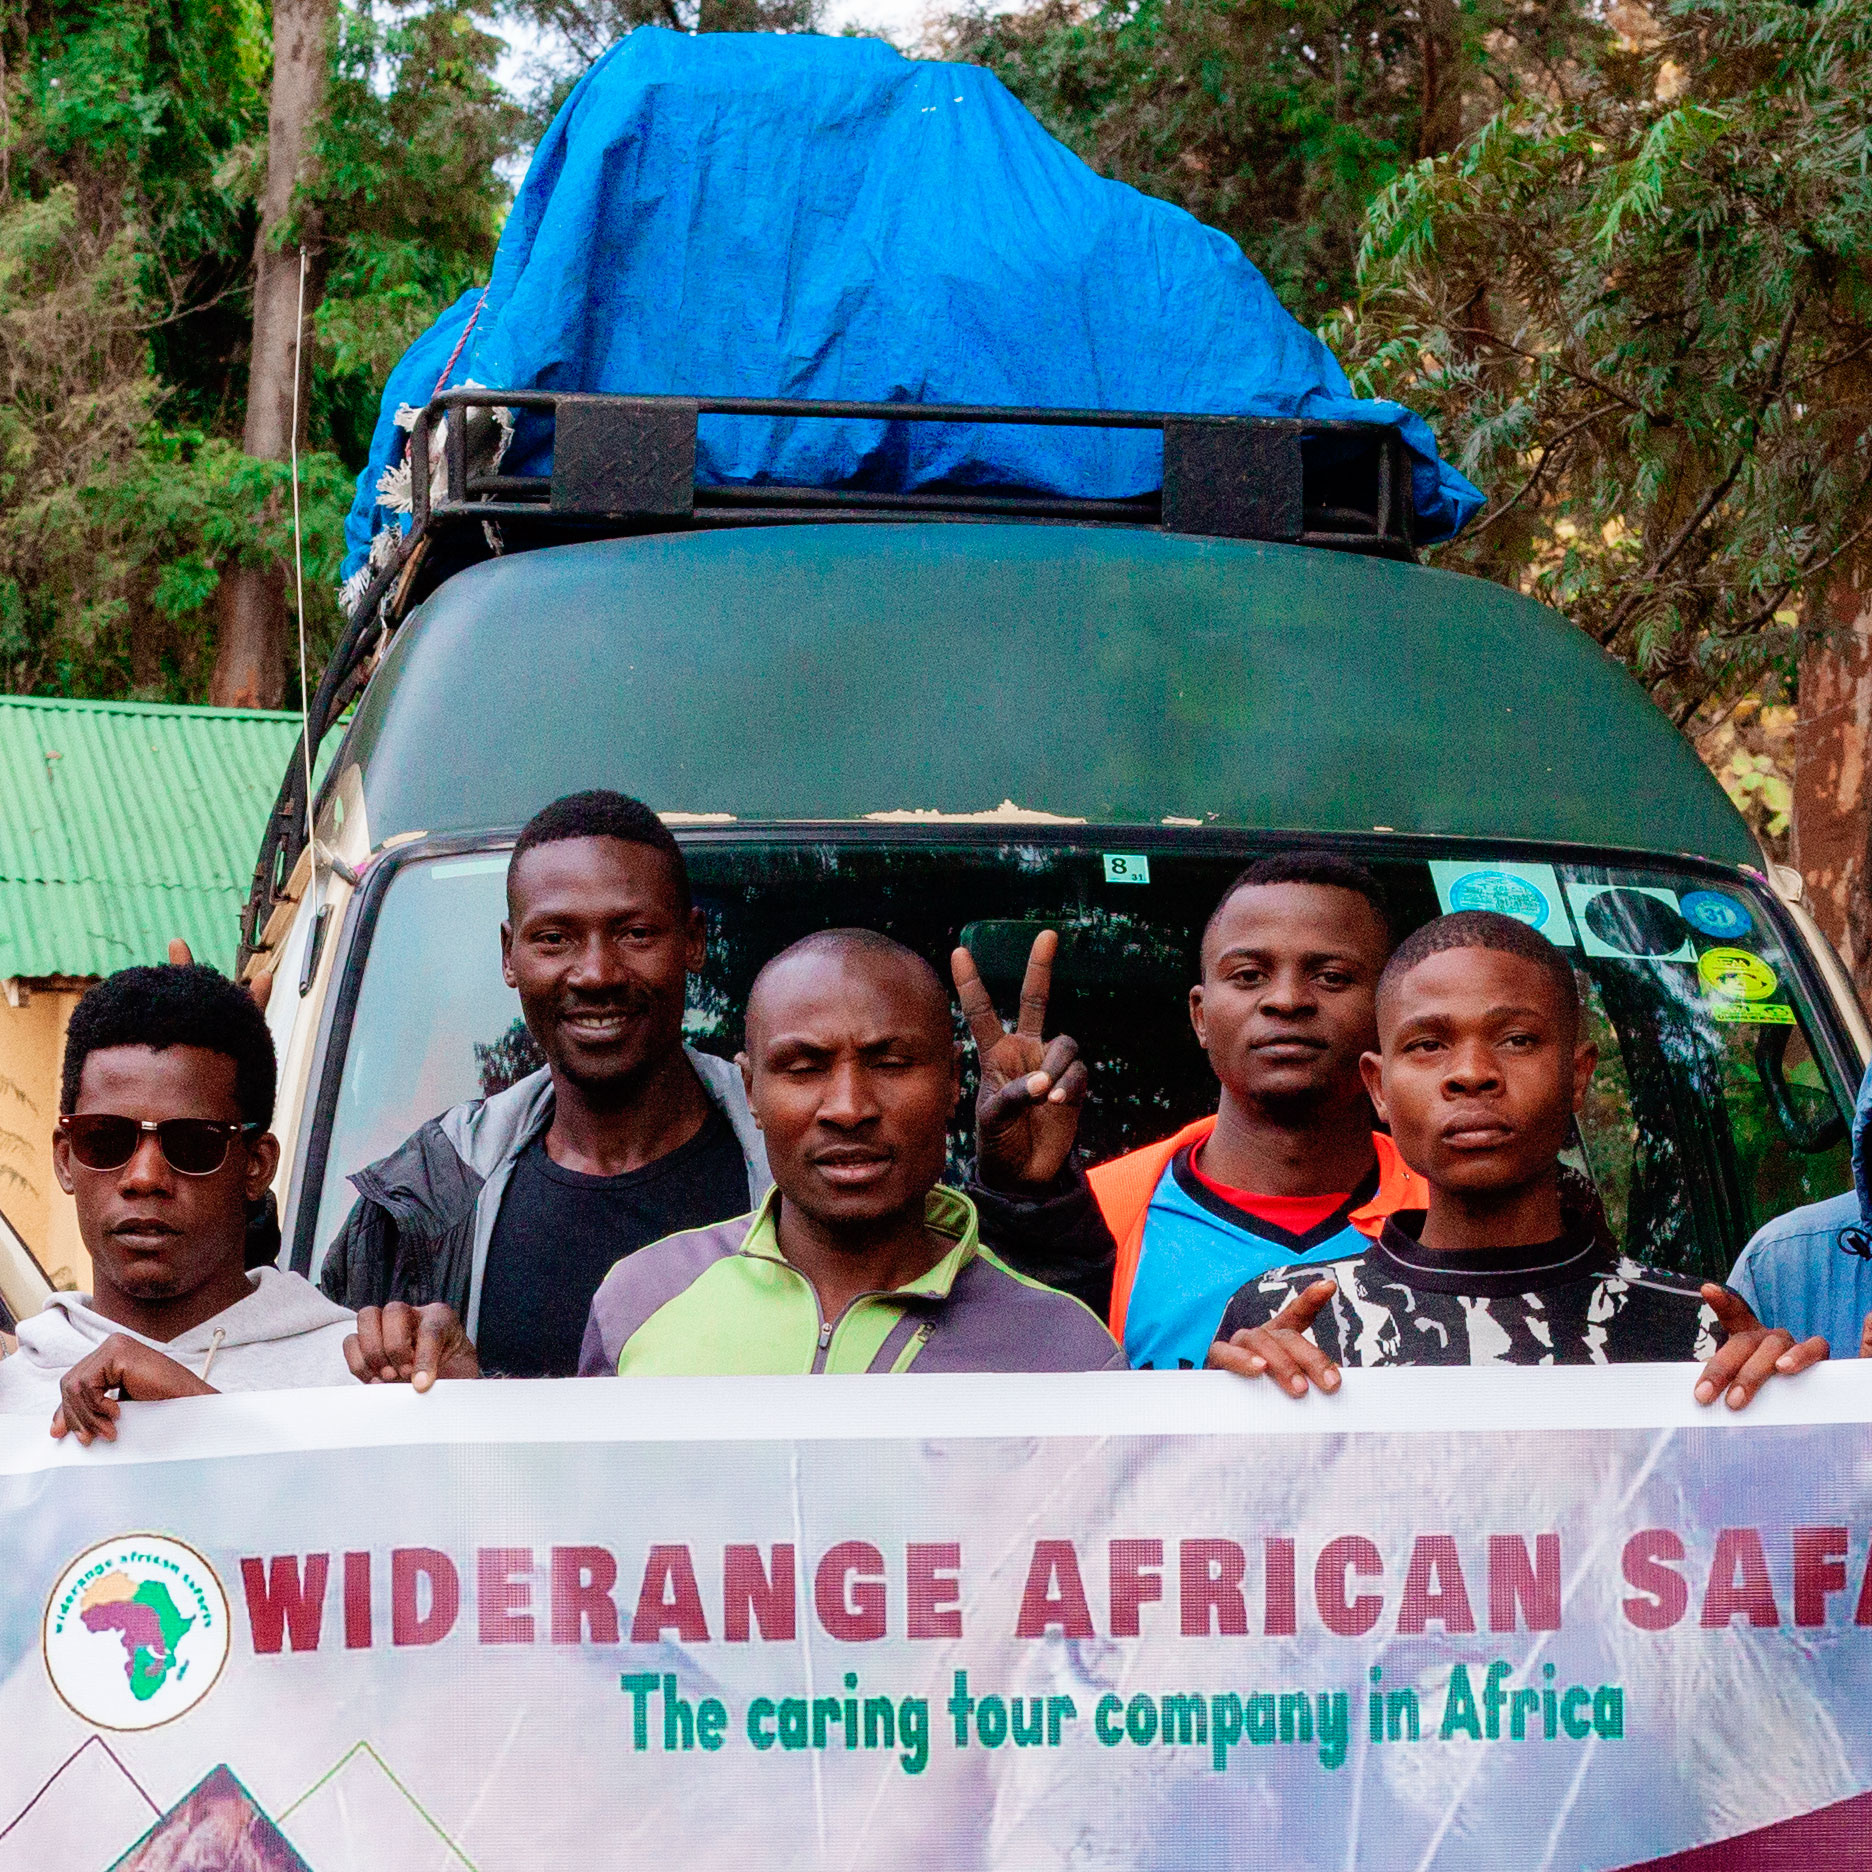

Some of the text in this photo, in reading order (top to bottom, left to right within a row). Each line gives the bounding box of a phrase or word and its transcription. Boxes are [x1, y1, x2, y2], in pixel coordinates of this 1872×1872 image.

[1111, 857, 1128, 874] 8
[1704, 907, 1728, 923] 31
[240, 1540, 965, 1654] WIDERANGE
[1016, 1533, 1562, 1638] AFRICAN
[620, 1660, 1625, 1774] The caring tour company in Africa
